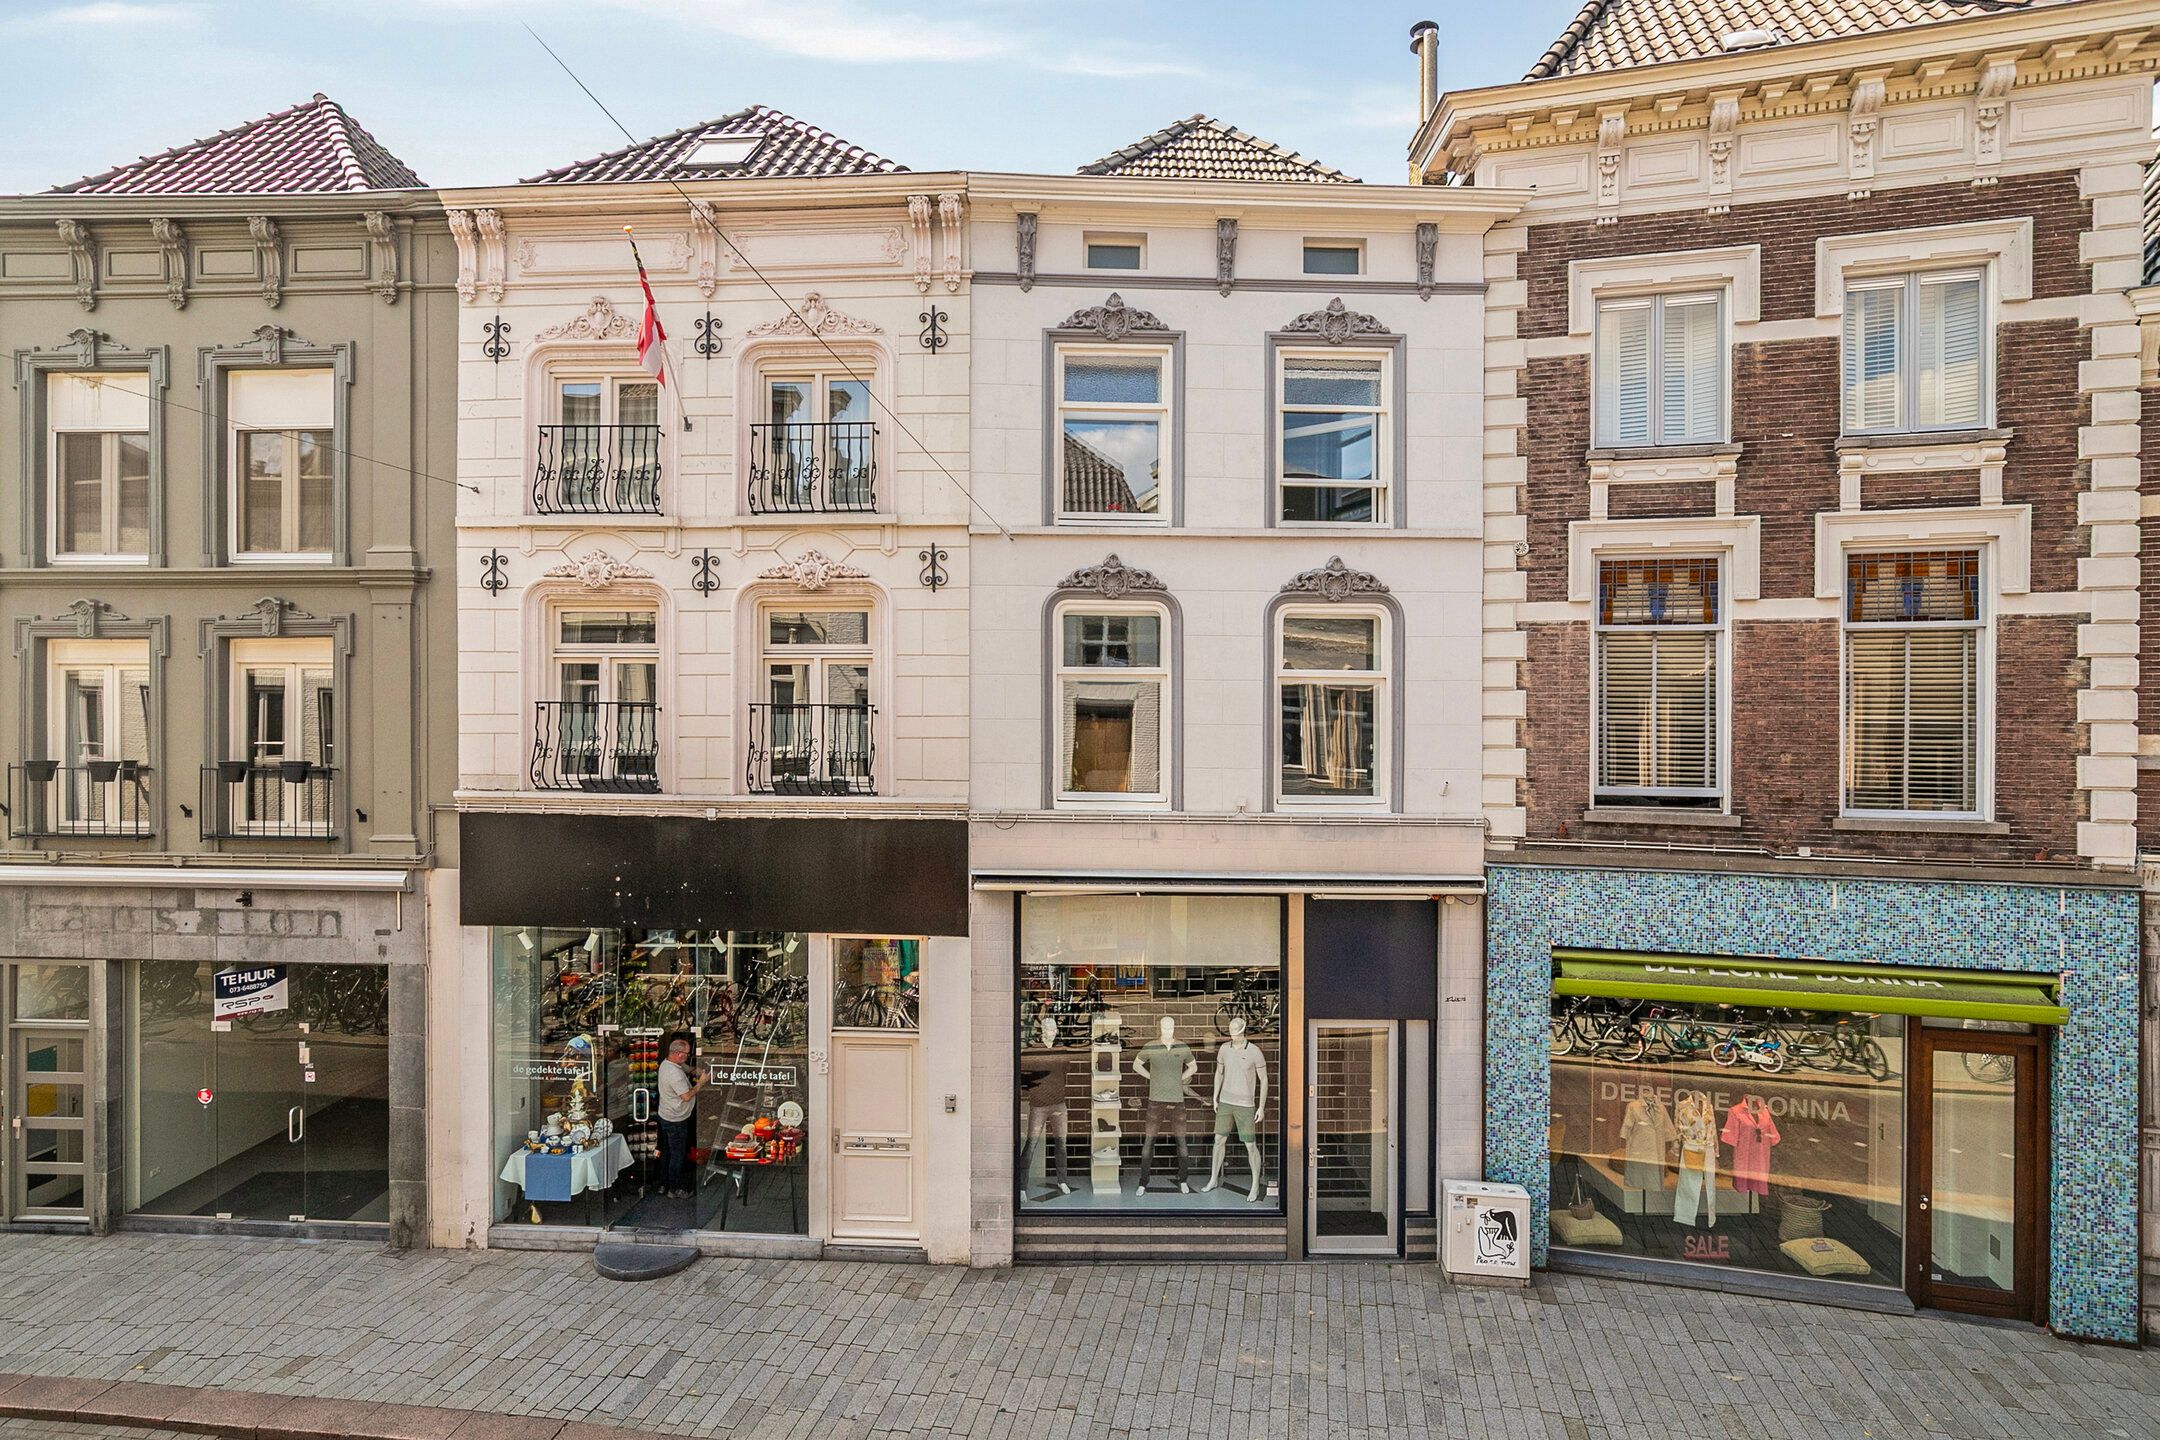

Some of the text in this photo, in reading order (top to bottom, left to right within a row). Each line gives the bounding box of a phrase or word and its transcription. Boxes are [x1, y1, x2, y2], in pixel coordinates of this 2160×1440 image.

[220, 968, 276, 986] TE HUUR
[221, 996, 261, 1010] RSP
[808, 1049, 828, 1061] 39
[512, 1064, 585, 1076] de gedekte tafel
[716, 1069, 791, 1081] de gedekte tafel
[818, 1061, 829, 1075] B
[1746, 1093, 1852, 1122] DONNA
[1684, 1235, 1730, 1257] SALE
